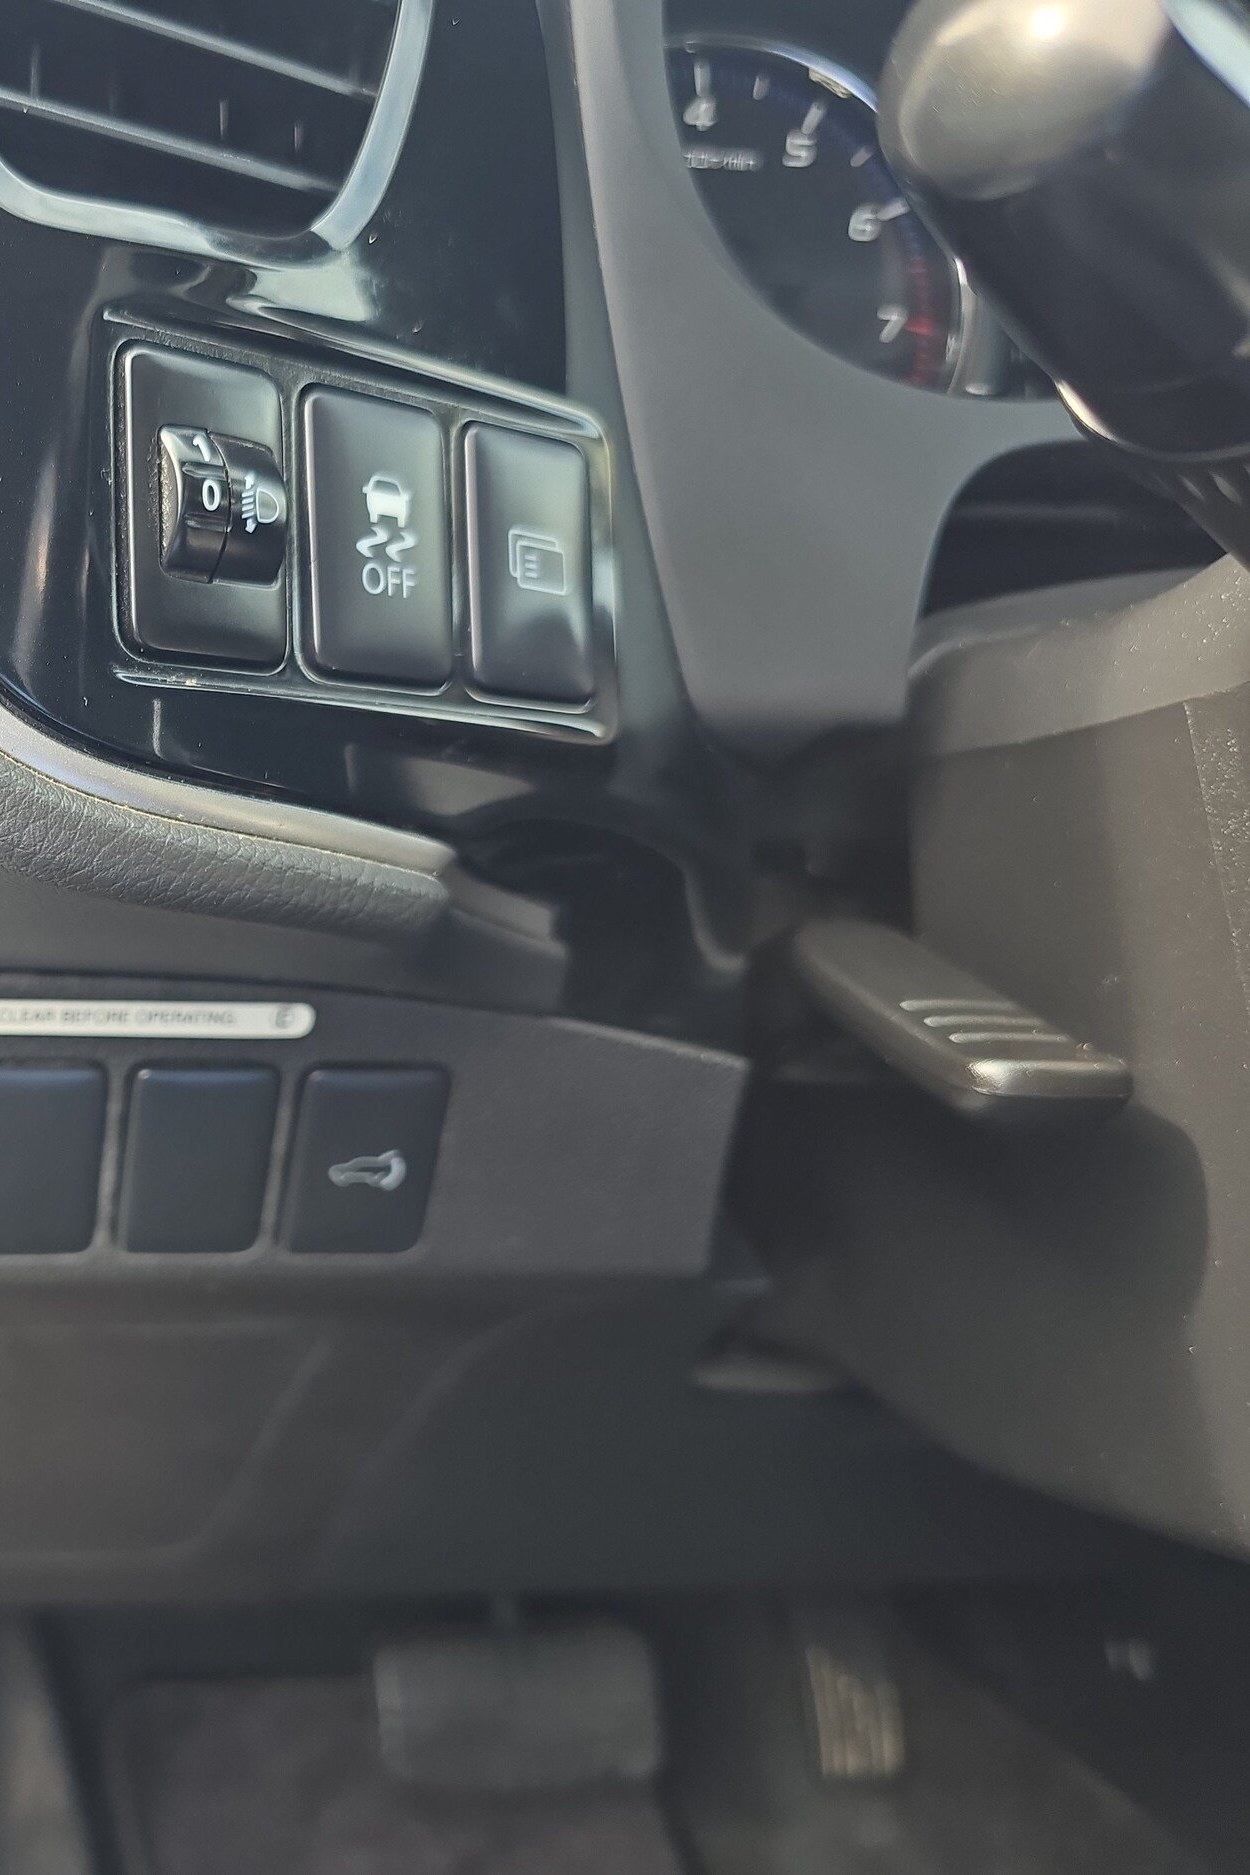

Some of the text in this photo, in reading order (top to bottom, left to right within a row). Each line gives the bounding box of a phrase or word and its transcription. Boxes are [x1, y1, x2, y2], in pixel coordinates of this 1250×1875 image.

[782, 128, 817, 168] 5
[848, 203, 881, 242] 6
[877, 304, 907, 343] 7
[193, 434, 211, 462] 1
[202, 478, 221, 511] 0
[362, 562, 416, 598] OFF
[61, 1007, 129, 1023] BEFORE
